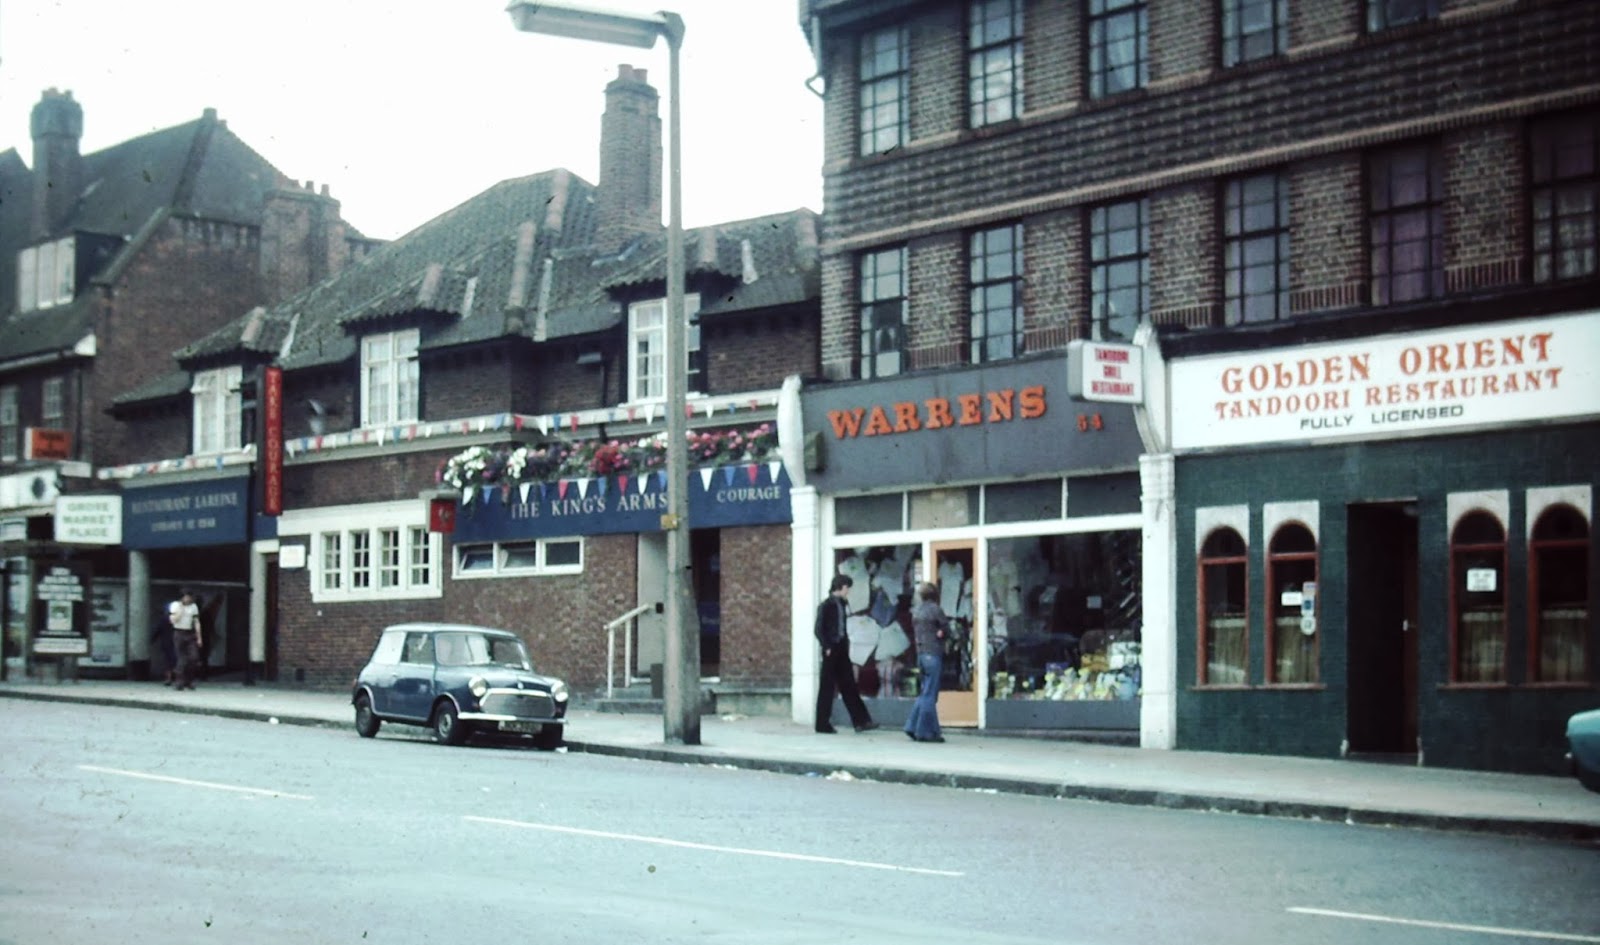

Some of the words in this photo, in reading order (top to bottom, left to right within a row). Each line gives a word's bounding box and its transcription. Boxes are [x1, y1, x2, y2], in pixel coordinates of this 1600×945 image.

[1221, 353, 1371, 394] GOLDEN
[1399, 331, 1554, 376] ORIENT
[827, 384, 1047, 439] WARRENS
[1215, 389, 1350, 420] TANDOORI
[1365, 367, 1563, 407] RESTAURANT
[1300, 415, 1354, 430] FULLY
[1371, 404, 1464, 424] LICENSED
[511, 501, 540, 519] THE
[551, 494, 607, 517] KING'S
[617, 492, 668, 512] ARMS
[716, 485, 781, 503] COURAGE
